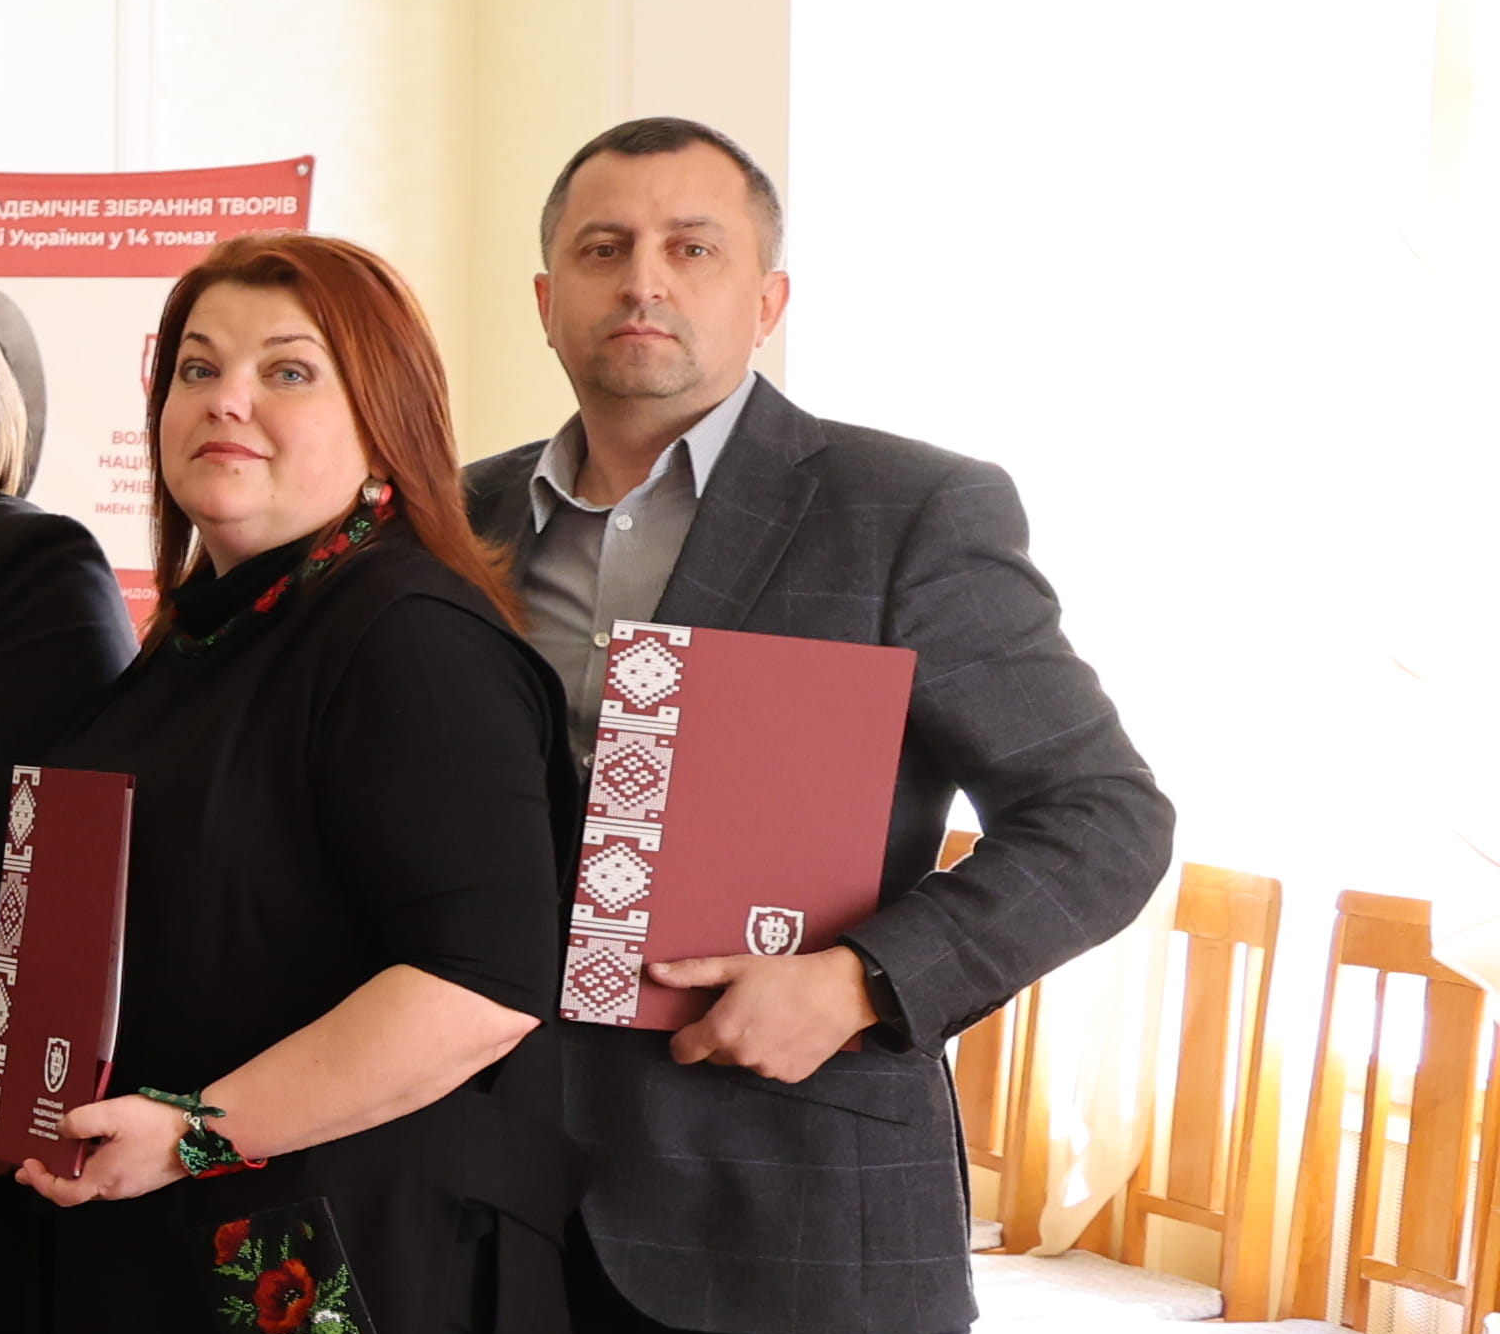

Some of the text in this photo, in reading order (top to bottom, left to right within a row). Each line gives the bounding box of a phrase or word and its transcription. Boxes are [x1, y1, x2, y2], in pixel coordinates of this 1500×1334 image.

[104, 198, 213, 217] ЗІБРАННЯ
[218, 196, 298, 215] ТВОРІВ
[9, 227, 105, 250] Українки
[107, 231, 123, 250] у
[127, 228, 149, 246] 14
[153, 231, 217, 246] томах
